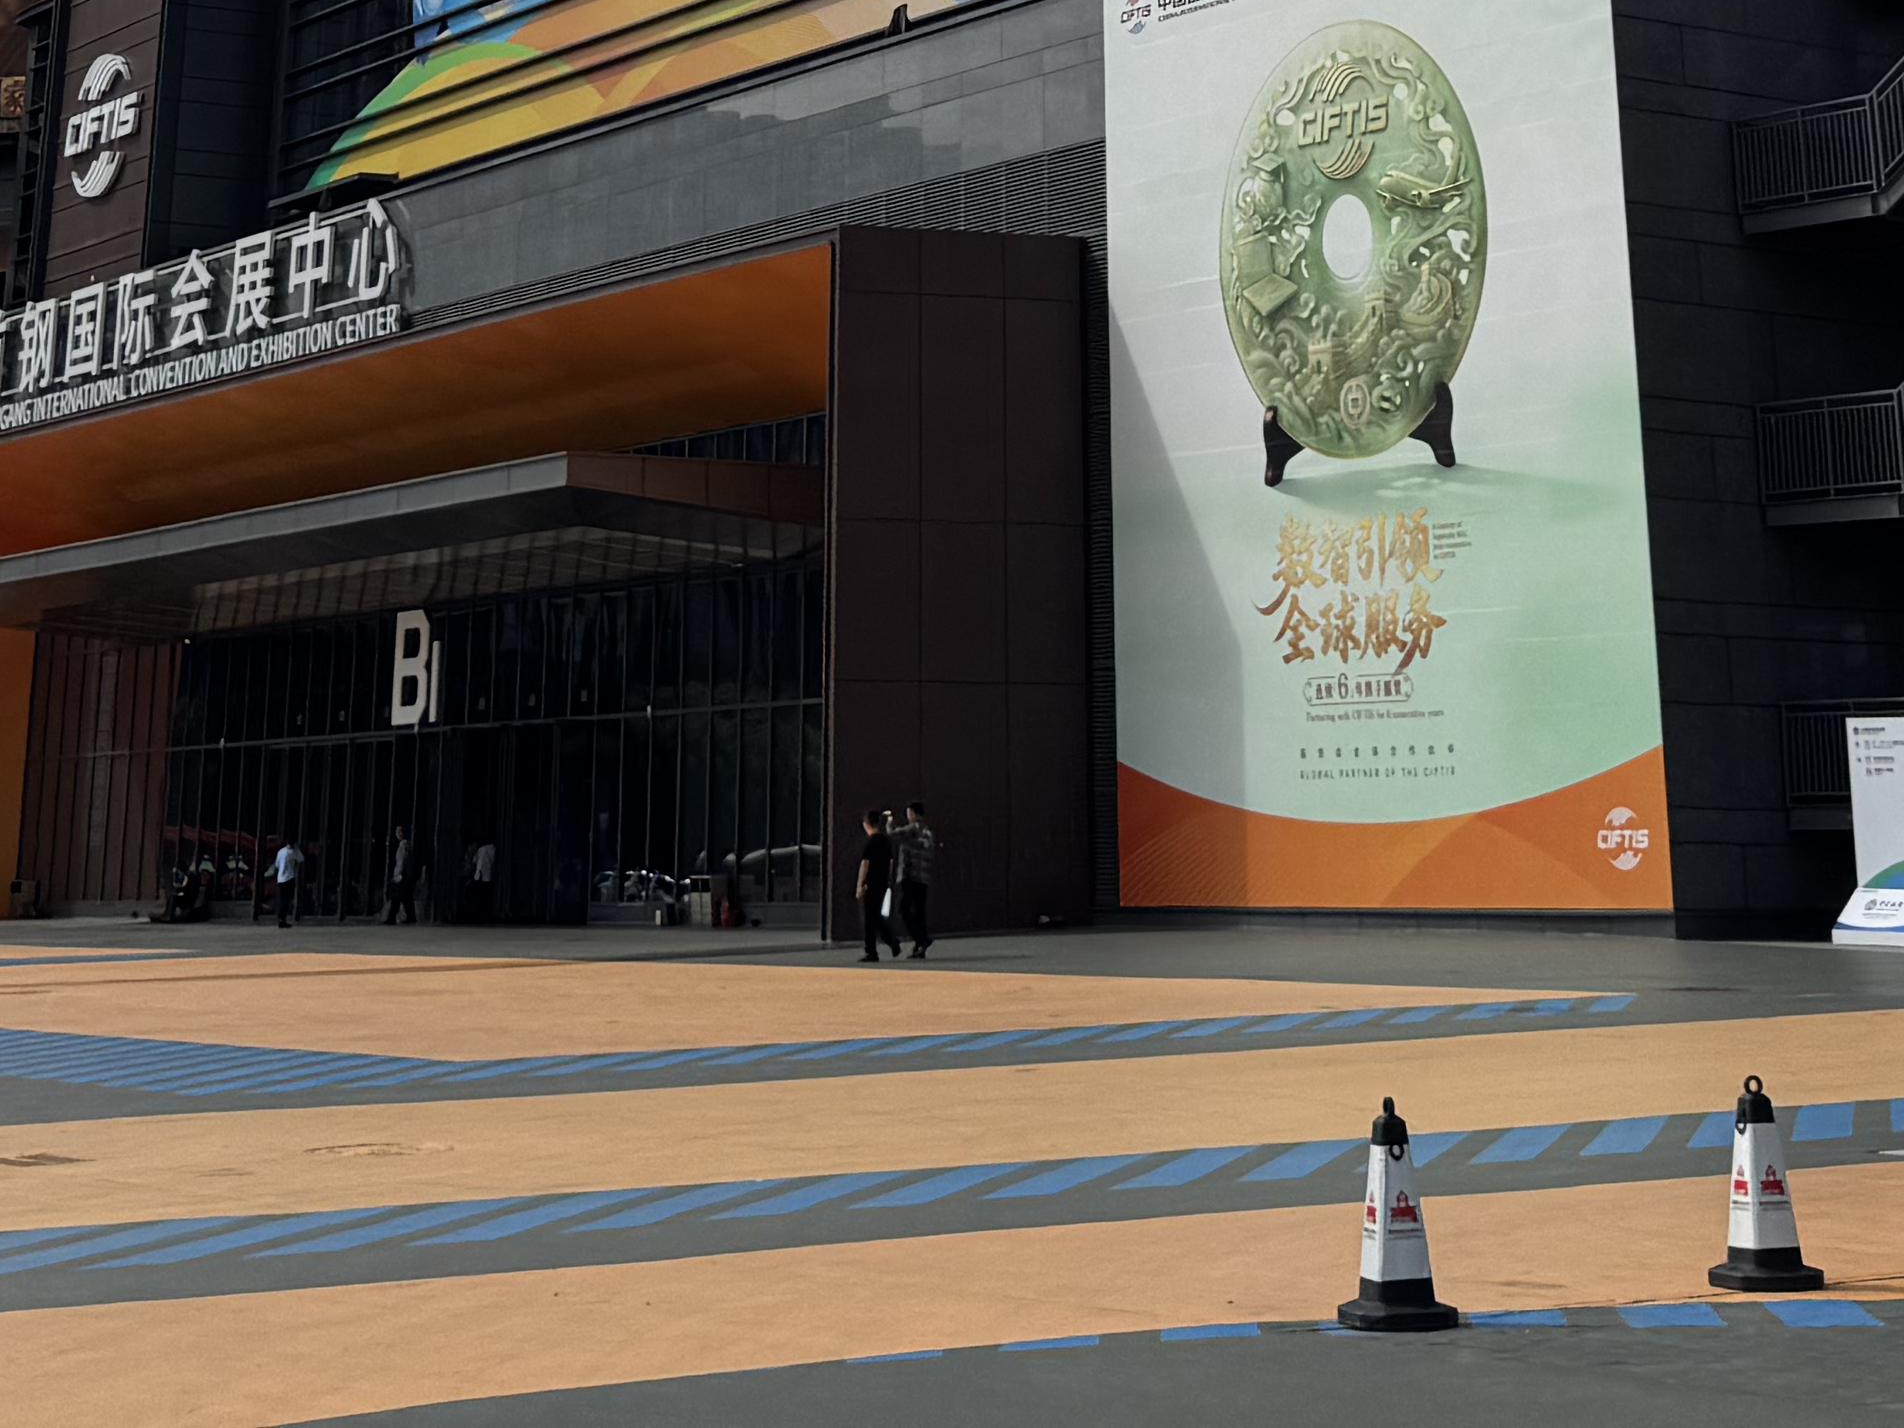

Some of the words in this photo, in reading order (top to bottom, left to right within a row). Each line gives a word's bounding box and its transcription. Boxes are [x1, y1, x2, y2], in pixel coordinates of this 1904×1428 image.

[64, 90, 144, 158] CIFTIS
[1297, 93, 1391, 148] CIFTIS
[33, 375, 127, 424] INTERNATIONAL
[130, 352, 221, 397] CONVENTION
[219, 343, 248, 375] AND
[251, 322, 332, 366] EXHIBITION
[335, 303, 399, 346] CENTER
[1273, 583, 1447, 675] 全球服务
[1598, 829, 1649, 849] CIFTIS
